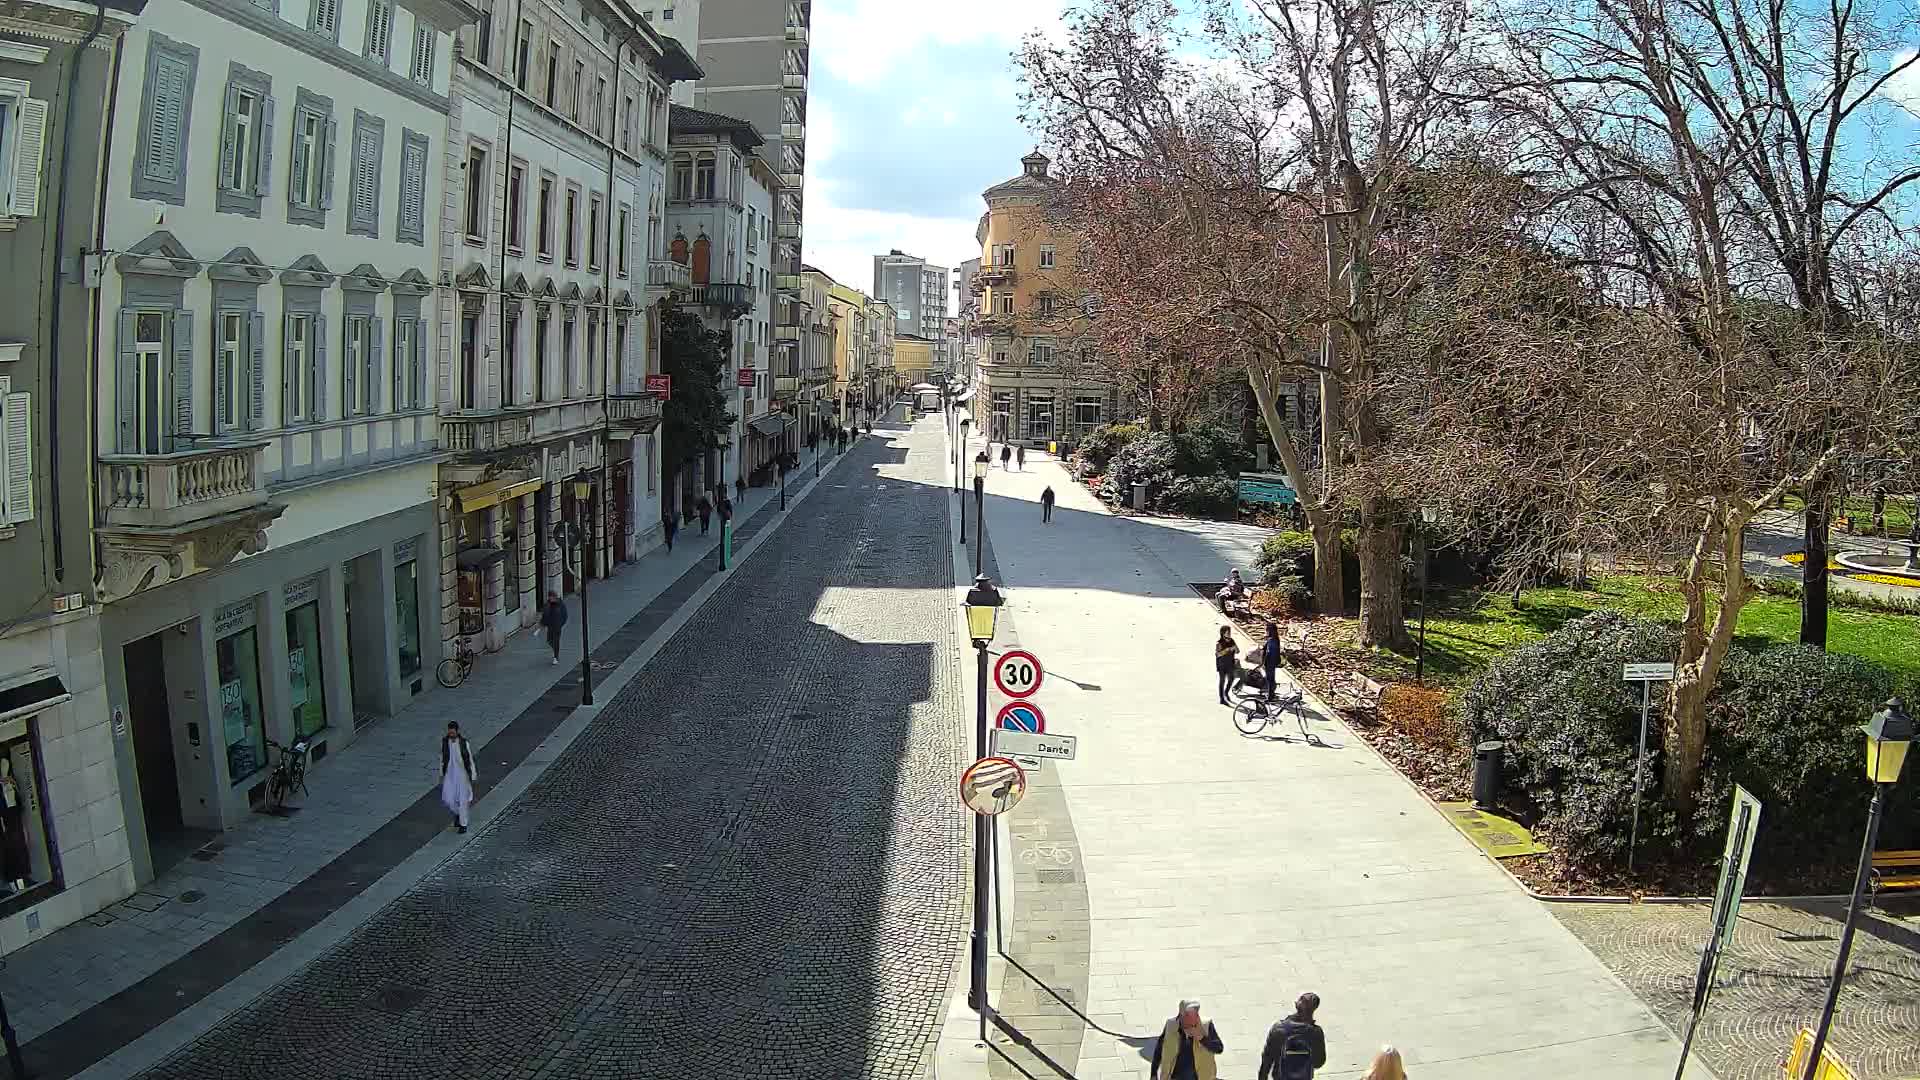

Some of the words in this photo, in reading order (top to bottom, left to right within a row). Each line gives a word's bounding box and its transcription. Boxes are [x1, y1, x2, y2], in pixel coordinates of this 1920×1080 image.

[1005, 663, 1033, 686] 30
[221, 683, 240, 705] 130
[1038, 744, 1069, 754] Dante
